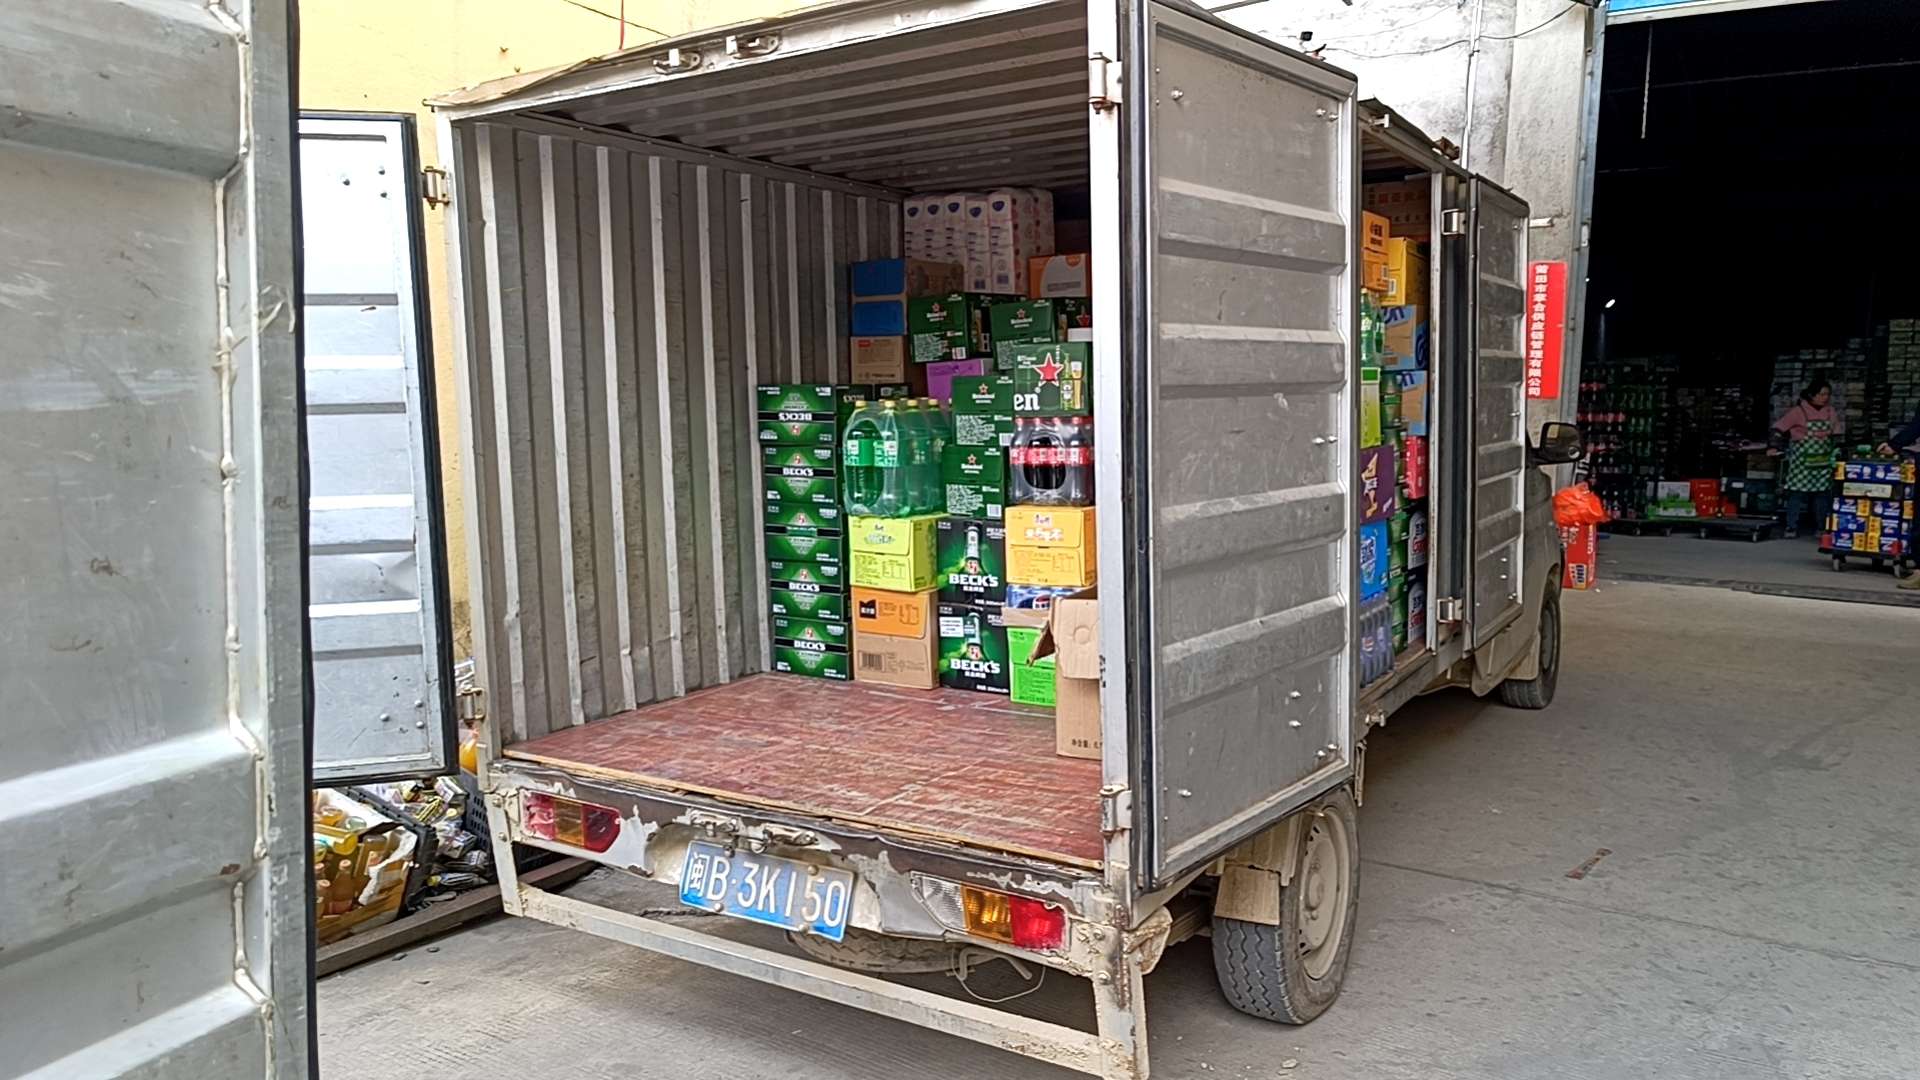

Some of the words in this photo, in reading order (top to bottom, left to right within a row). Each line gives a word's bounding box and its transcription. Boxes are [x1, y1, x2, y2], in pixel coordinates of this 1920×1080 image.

[949, 573, 999, 588] BECK'S
[788, 582, 820, 593] BECK'S
[793, 639, 826, 651] BECK'S
[950, 658, 1001, 674] BECK'S
